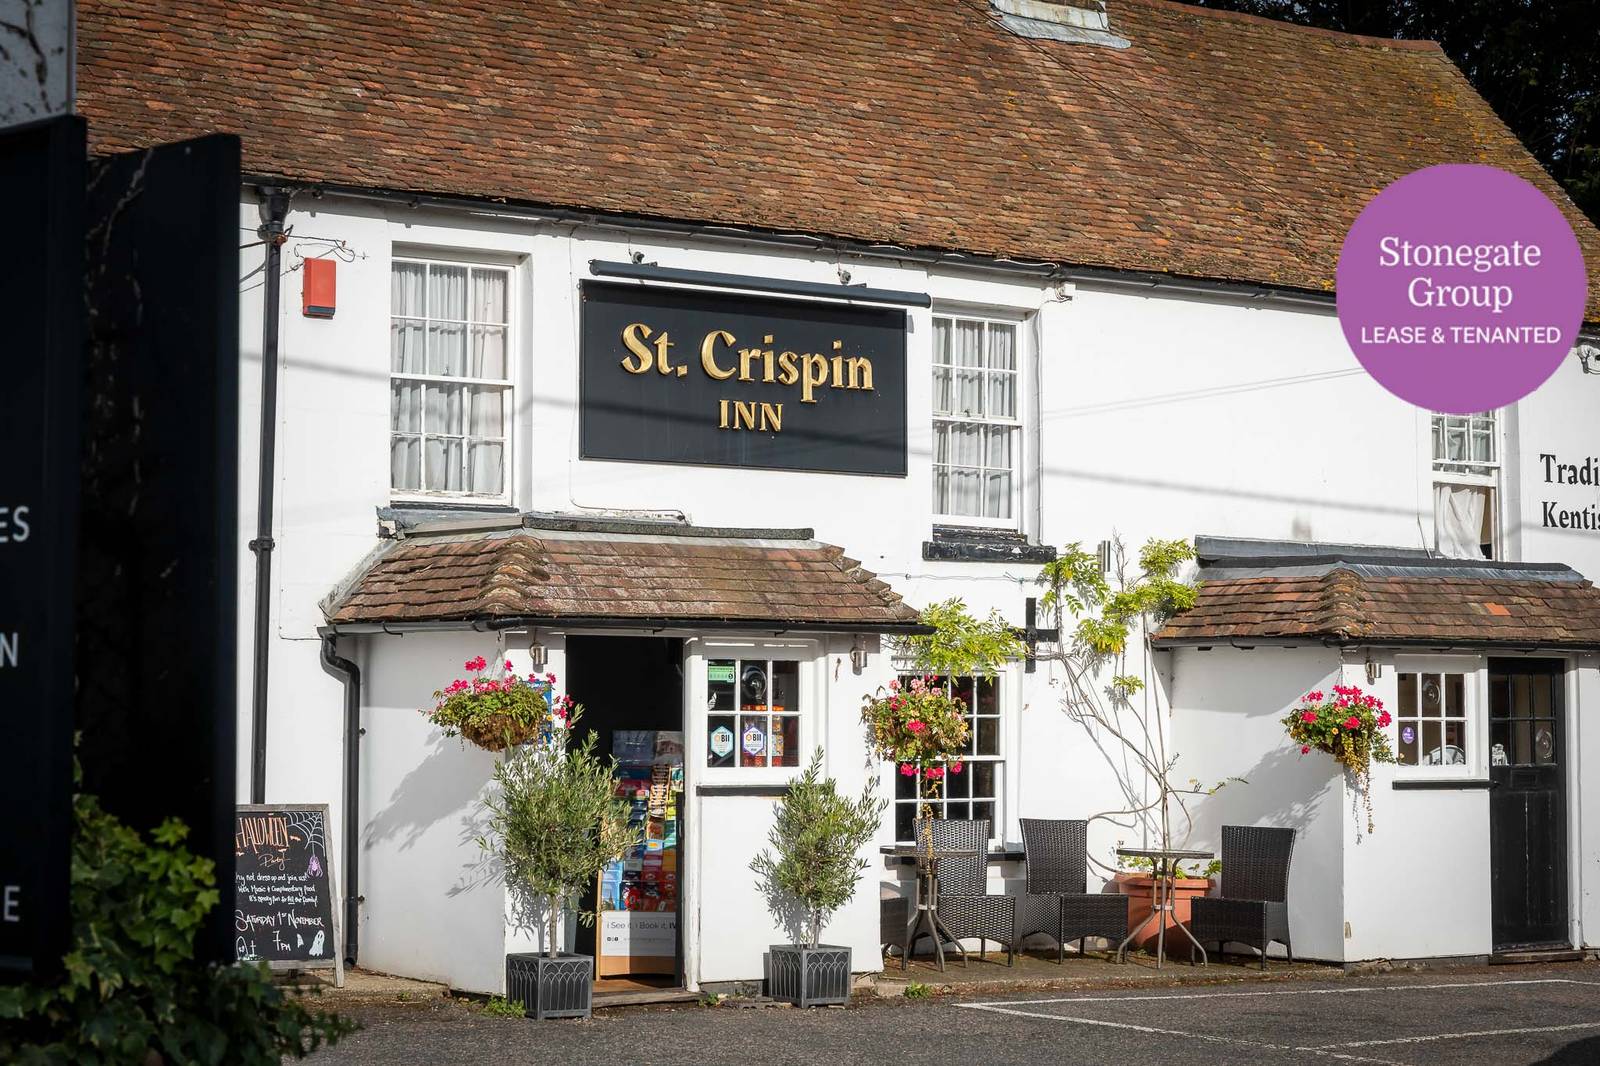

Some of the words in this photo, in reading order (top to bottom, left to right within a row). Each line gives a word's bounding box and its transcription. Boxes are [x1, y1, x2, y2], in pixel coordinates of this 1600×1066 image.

[621, 323, 688, 377] St.
[701, 329, 875, 403] Crispin
[719, 399, 783, 431] INN
[4, 886, 20, 921] E
